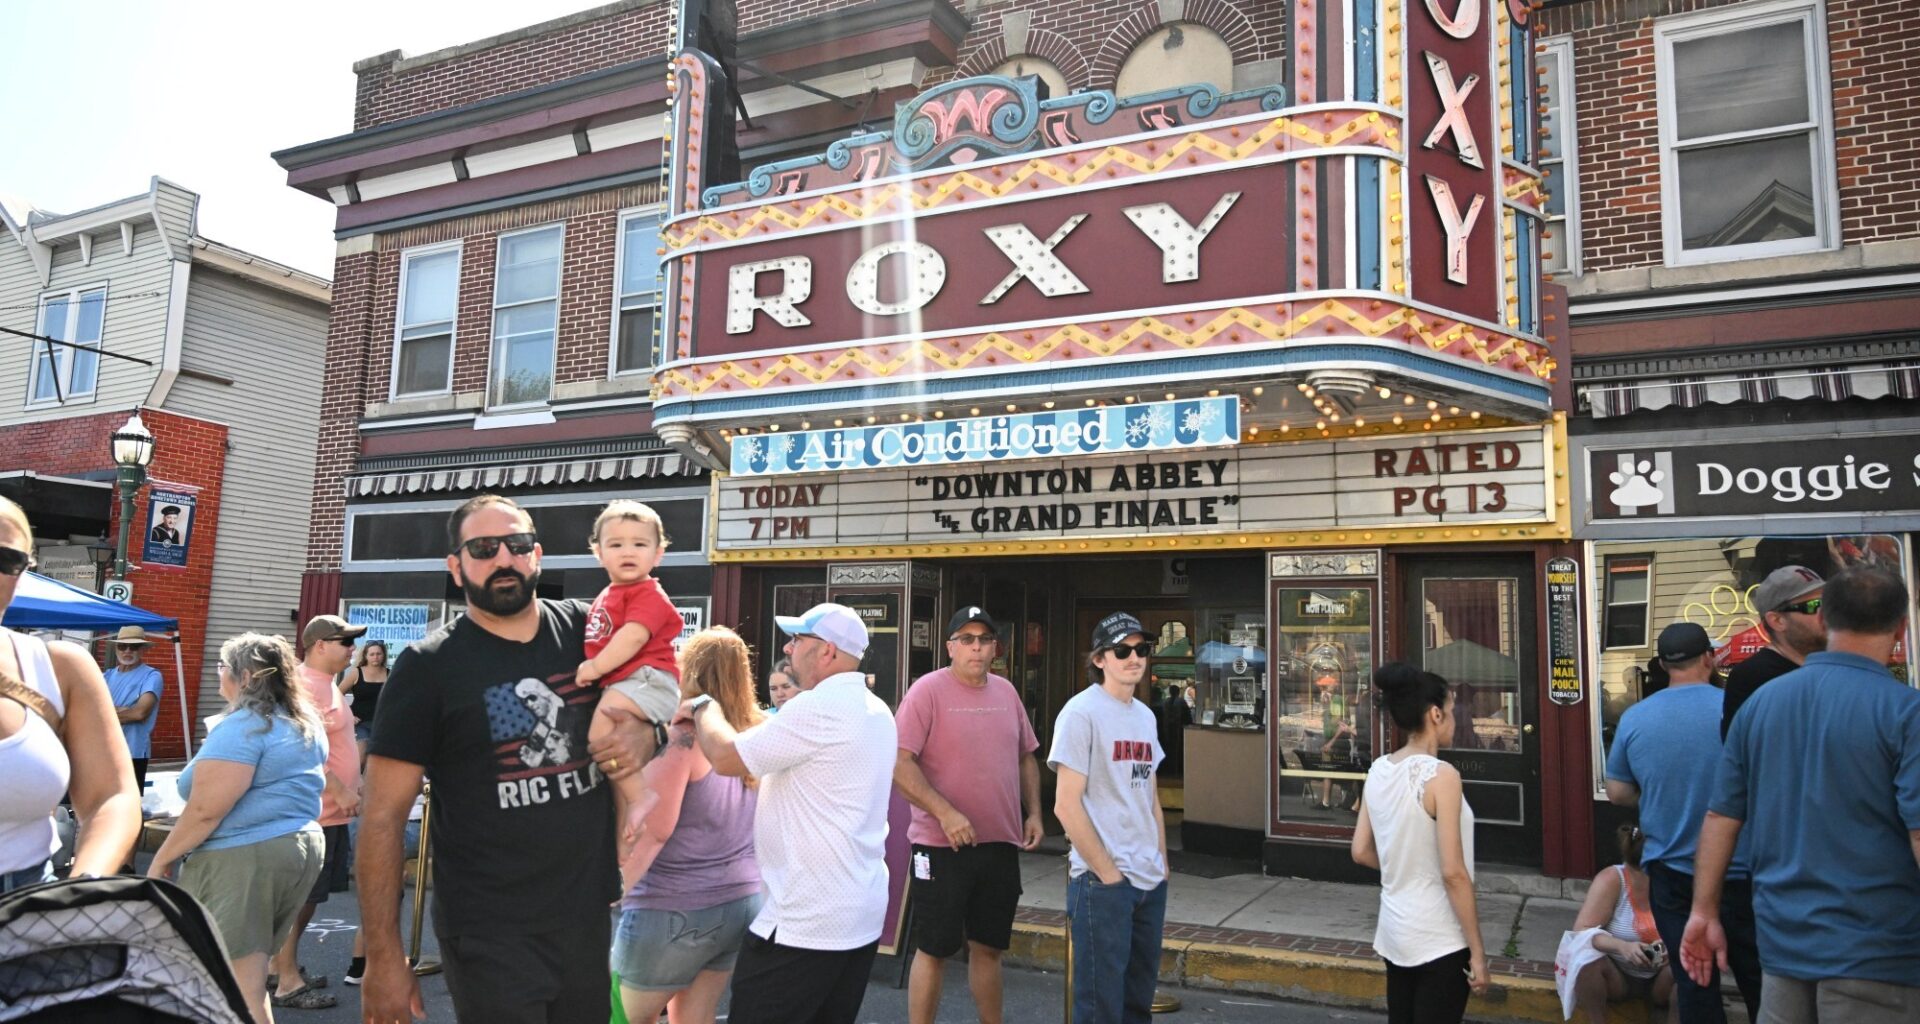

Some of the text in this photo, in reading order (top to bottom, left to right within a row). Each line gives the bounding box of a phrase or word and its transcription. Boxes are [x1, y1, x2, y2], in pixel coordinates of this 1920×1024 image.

[726, 191, 1243, 334] ROXY
[795, 409, 1112, 464] Air Conditioned
[1109, 459, 1228, 491] ABBEY
[1374, 441, 1521, 478] RATED
[1697, 454, 1891, 502] Doggie
[739, 483, 824, 509] TODAY
[1394, 482, 1507, 517] PG 13
[748, 516, 810, 540] 7 PM
[932, 510, 960, 534] THE
[971, 503, 1081, 533] GRAND
[351, 607, 427, 625] MUSIC LESSON
[862, 608, 883, 617] PLAYING
[1305, 602, 1345, 614] NOW PLAYING
[368, 626, 426, 640] CERTIFICATES
[1551, 679, 1579, 689] POUCH
[1553, 667, 1576, 677] MAIL
[497, 775, 551, 809] RIC
[557, 761, 604, 799] FLA
